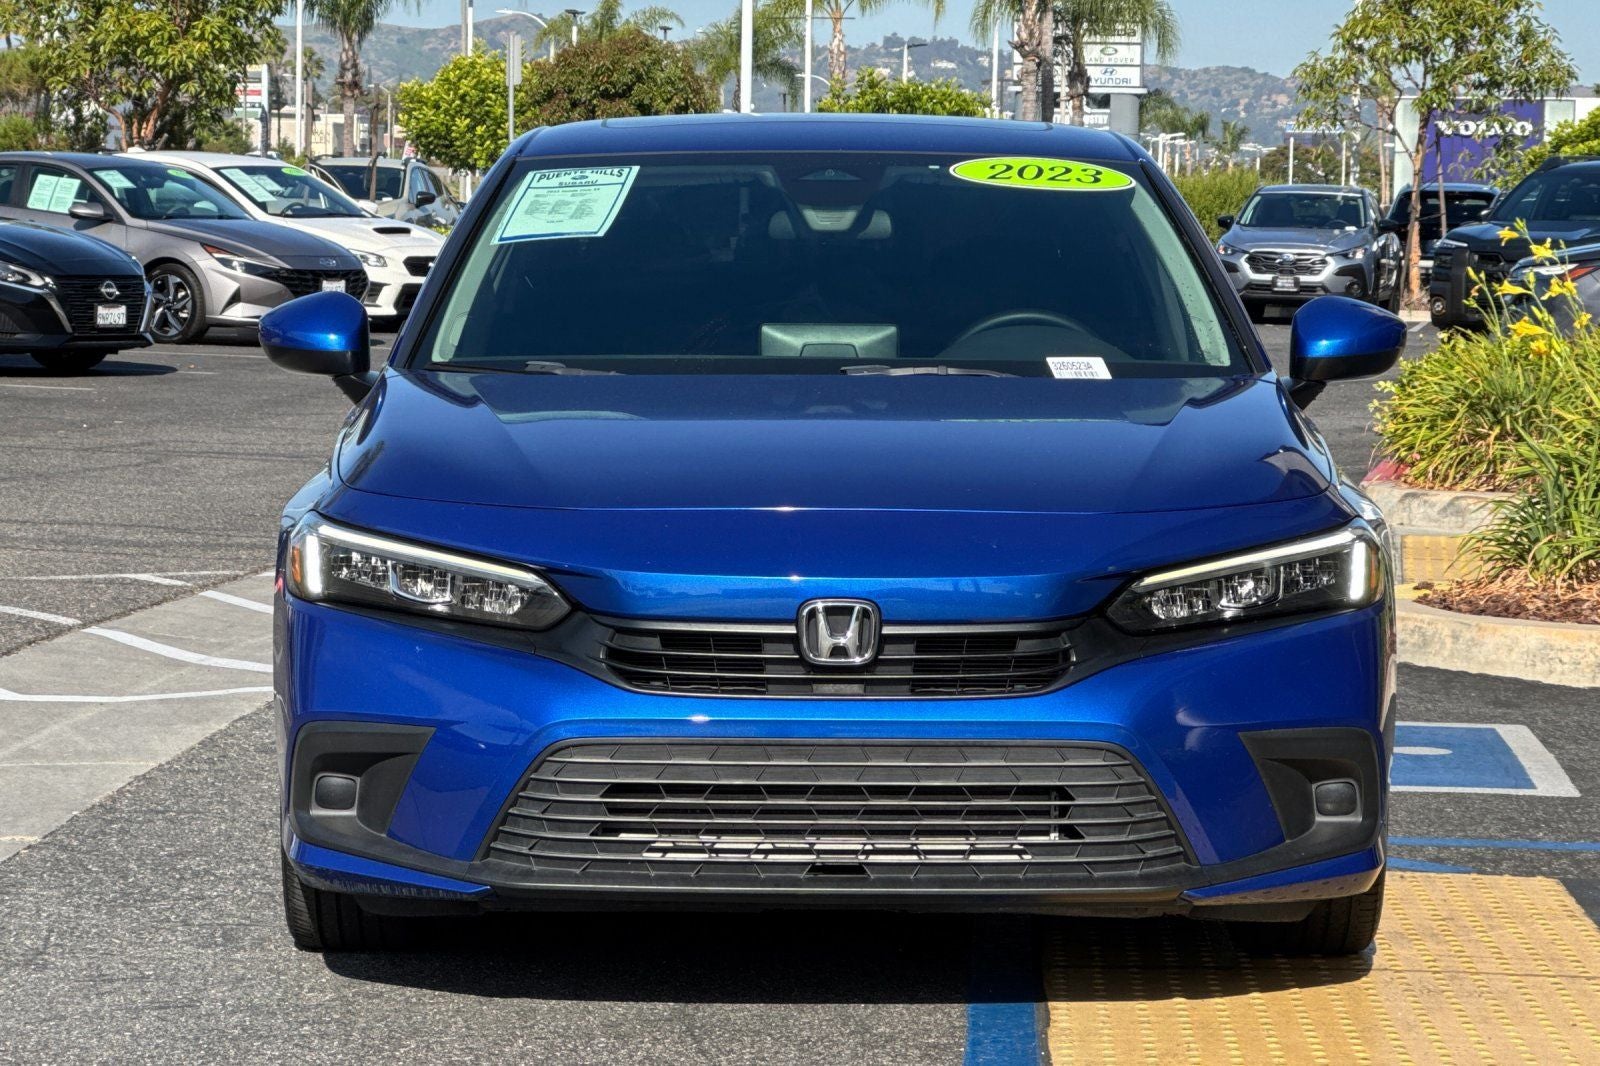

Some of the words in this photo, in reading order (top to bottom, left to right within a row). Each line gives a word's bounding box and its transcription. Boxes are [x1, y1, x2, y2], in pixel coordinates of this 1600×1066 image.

[537, 169, 587, 182] PUENTE
[590, 168, 625, 178] HILLS
[986, 163, 1102, 184] 2023
